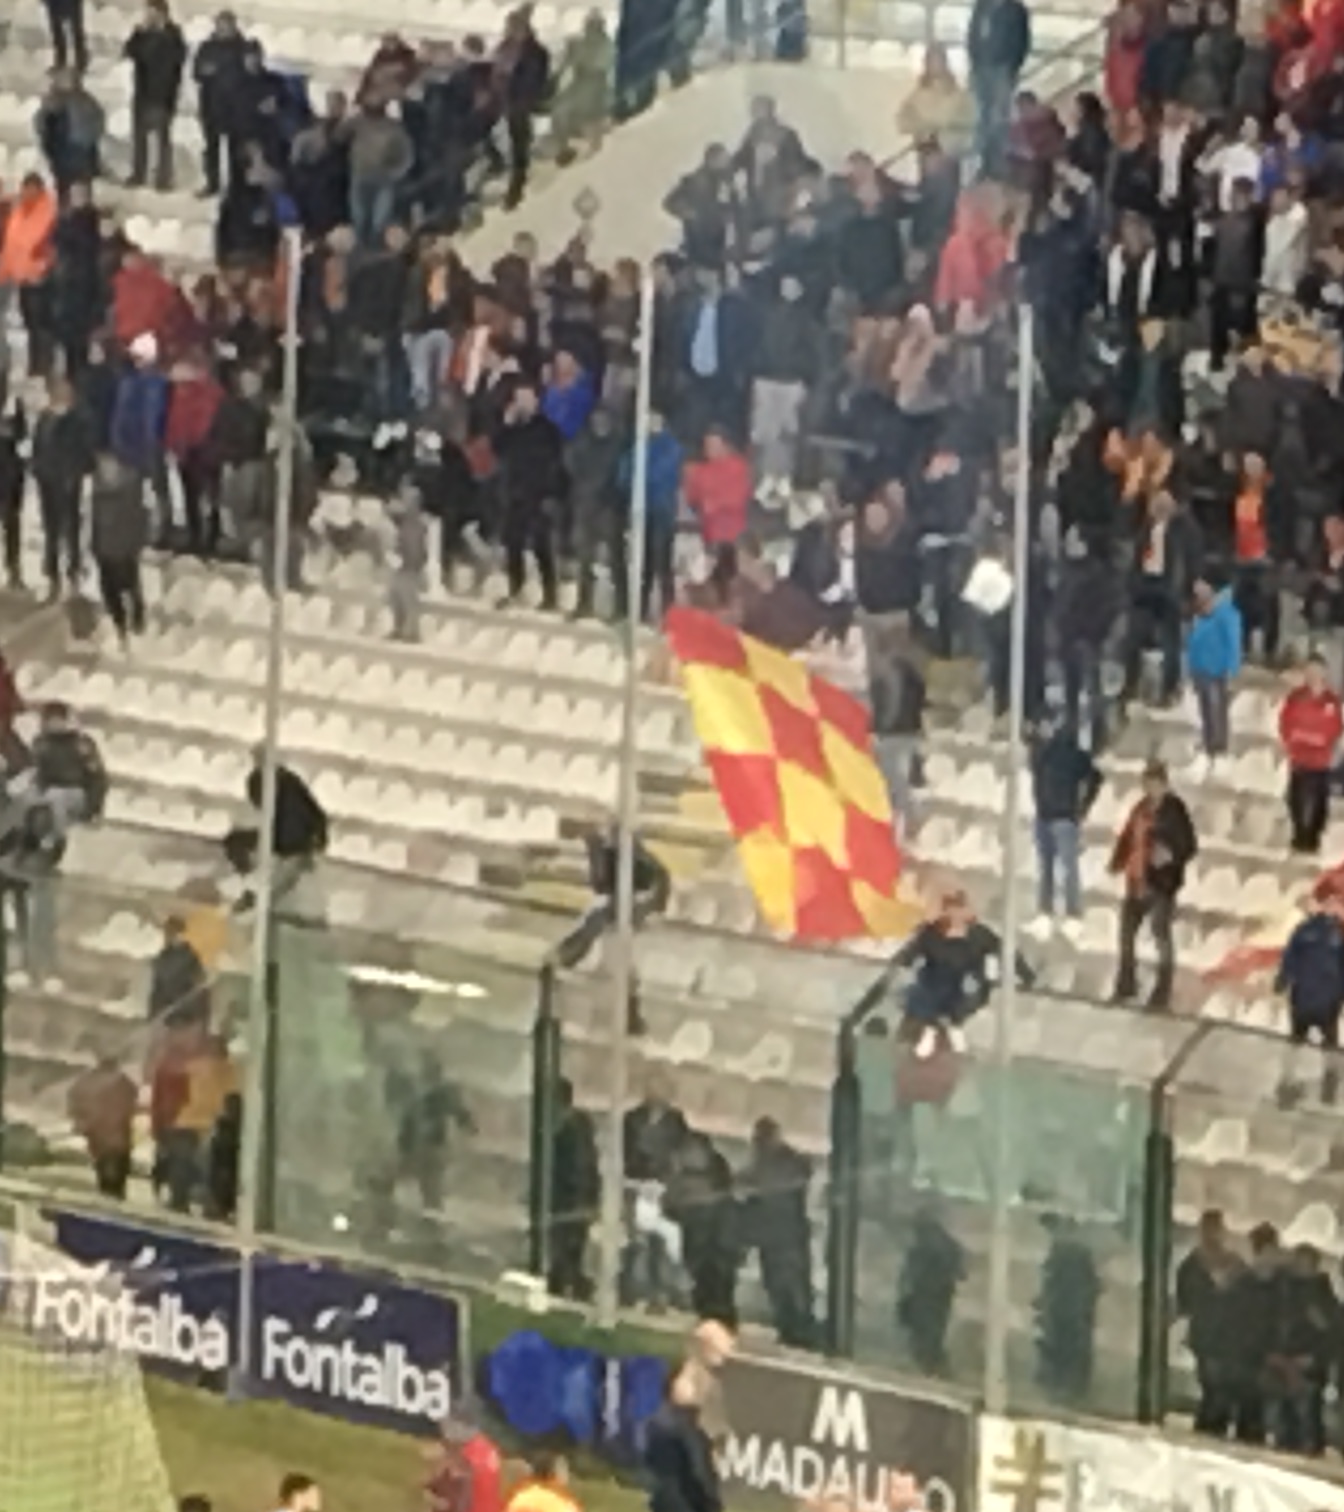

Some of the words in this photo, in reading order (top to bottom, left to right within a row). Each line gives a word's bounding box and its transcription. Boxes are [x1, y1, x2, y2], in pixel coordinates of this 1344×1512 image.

[32, 1271, 229, 1371] Fontalba
[261, 1314, 451, 1421] Fontalba
[810, 1385, 870, 1452] M
